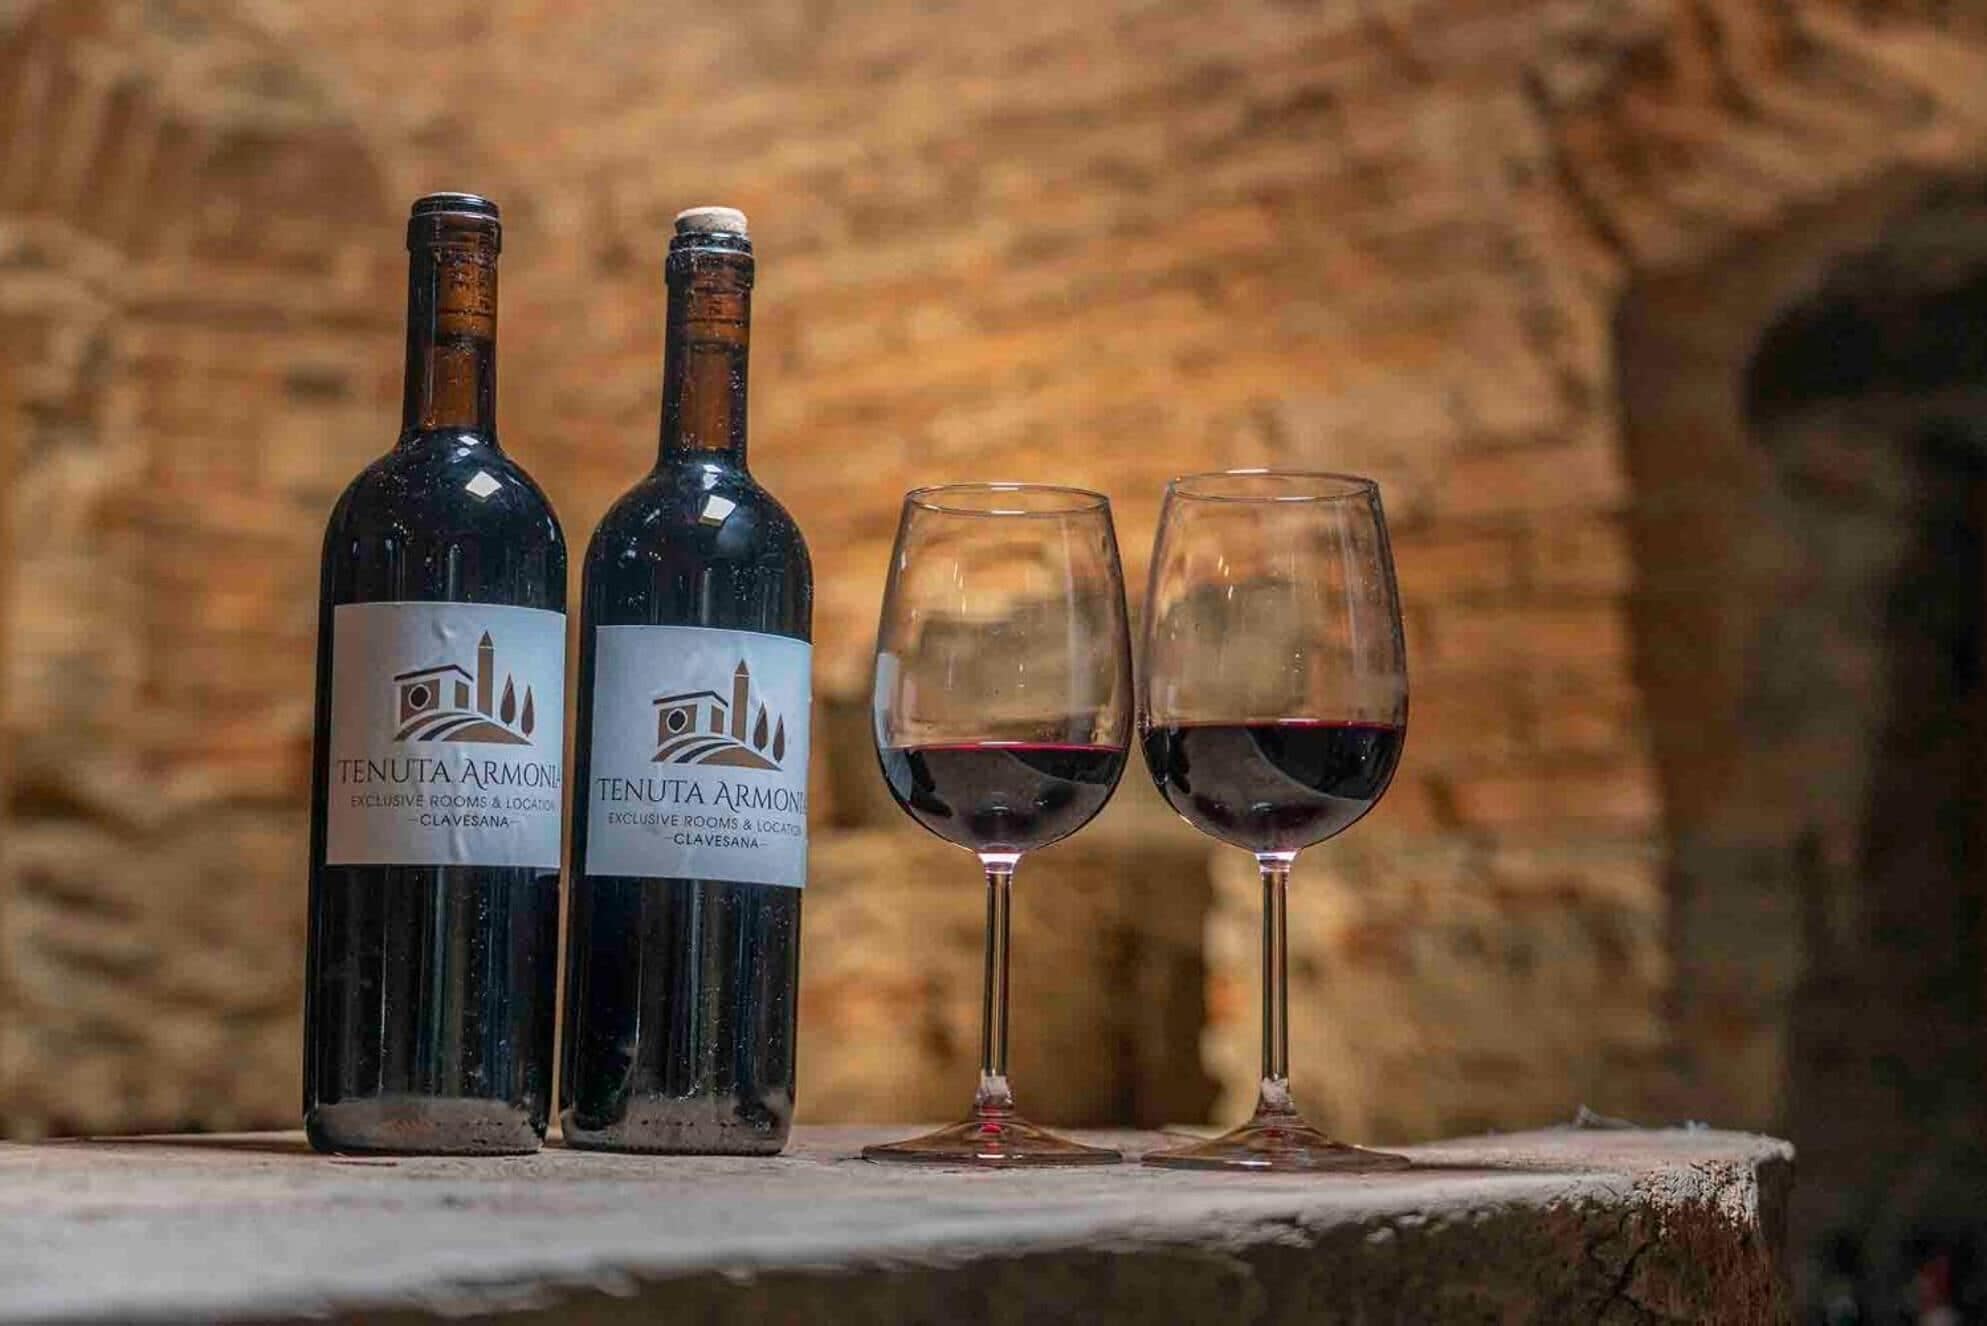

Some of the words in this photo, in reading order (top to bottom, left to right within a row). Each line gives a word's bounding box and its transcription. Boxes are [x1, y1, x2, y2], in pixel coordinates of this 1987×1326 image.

[337, 757, 451, 784] TENUTA
[351, 793, 424, 809] EXCLUSIVE
[430, 795, 487, 809] ROOMS
[491, 797, 502, 809] &
[597, 778, 706, 805] TENUTA
[713, 780, 808, 815] ARMONI
[608, 812, 679, 827] EXCLUSIVE
[683, 816, 739, 830] ROOMS
[742, 818, 752, 831] &
